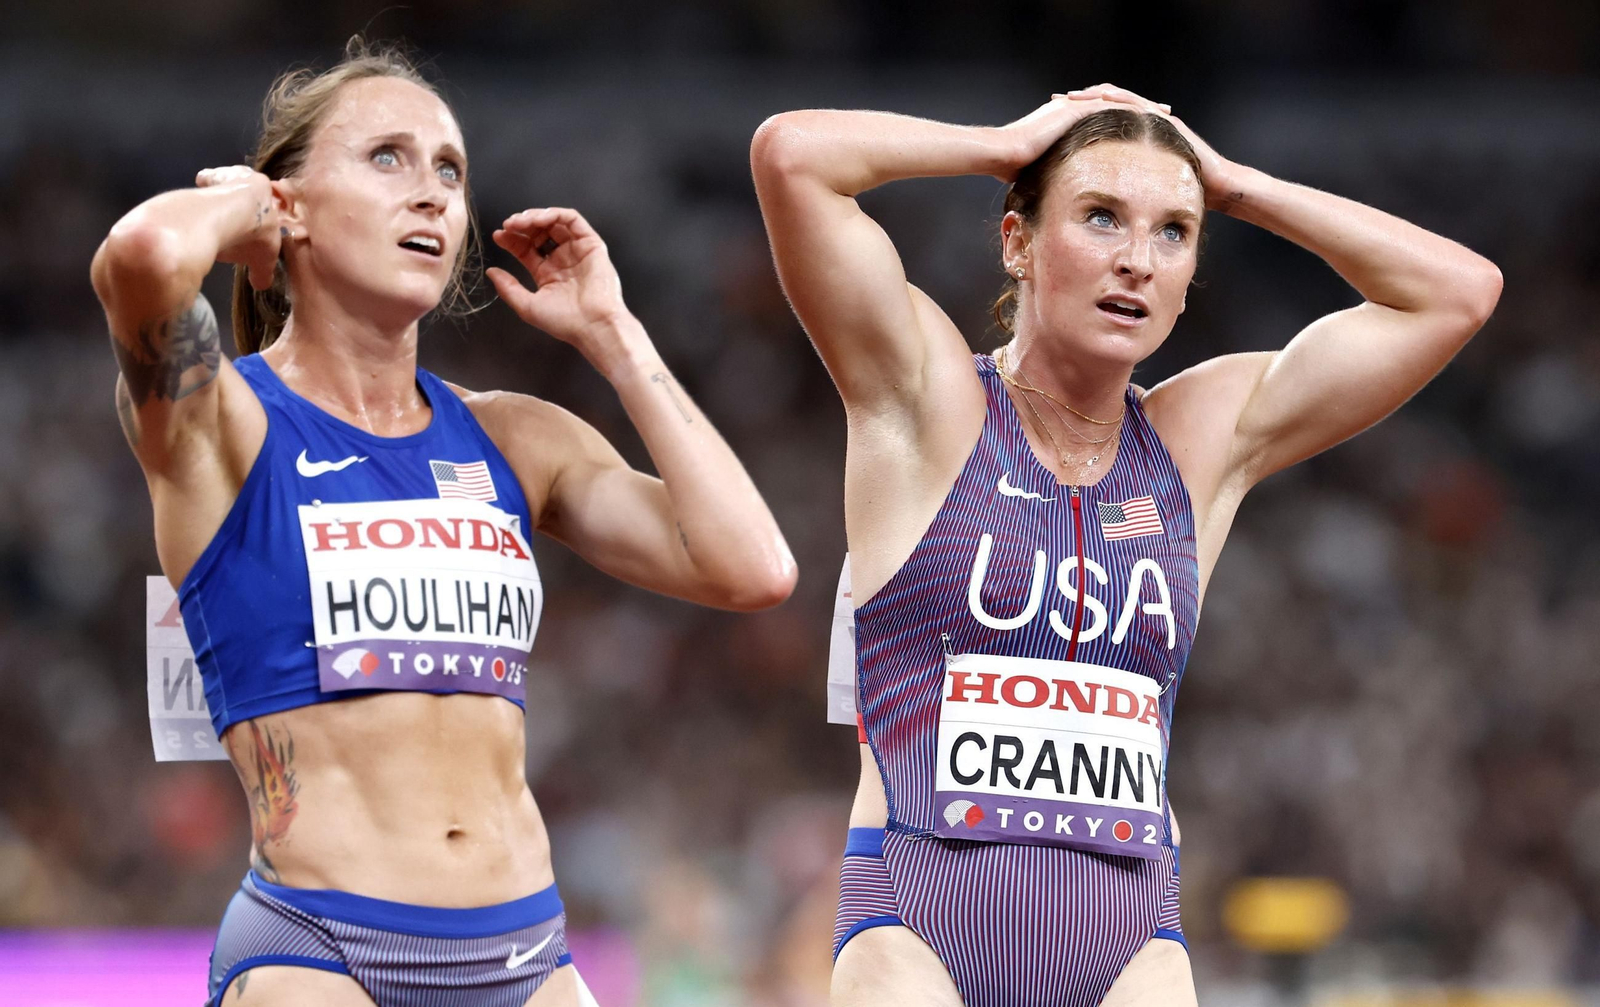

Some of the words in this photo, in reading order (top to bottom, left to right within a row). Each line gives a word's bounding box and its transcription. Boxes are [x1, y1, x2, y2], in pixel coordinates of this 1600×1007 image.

[308, 517, 531, 561] HONDA
[326, 577, 535, 643] HOULIHAN
[968, 533, 1176, 650] USA
[946, 670, 1161, 729] HONDA
[949, 731, 1162, 808] CRANNY
